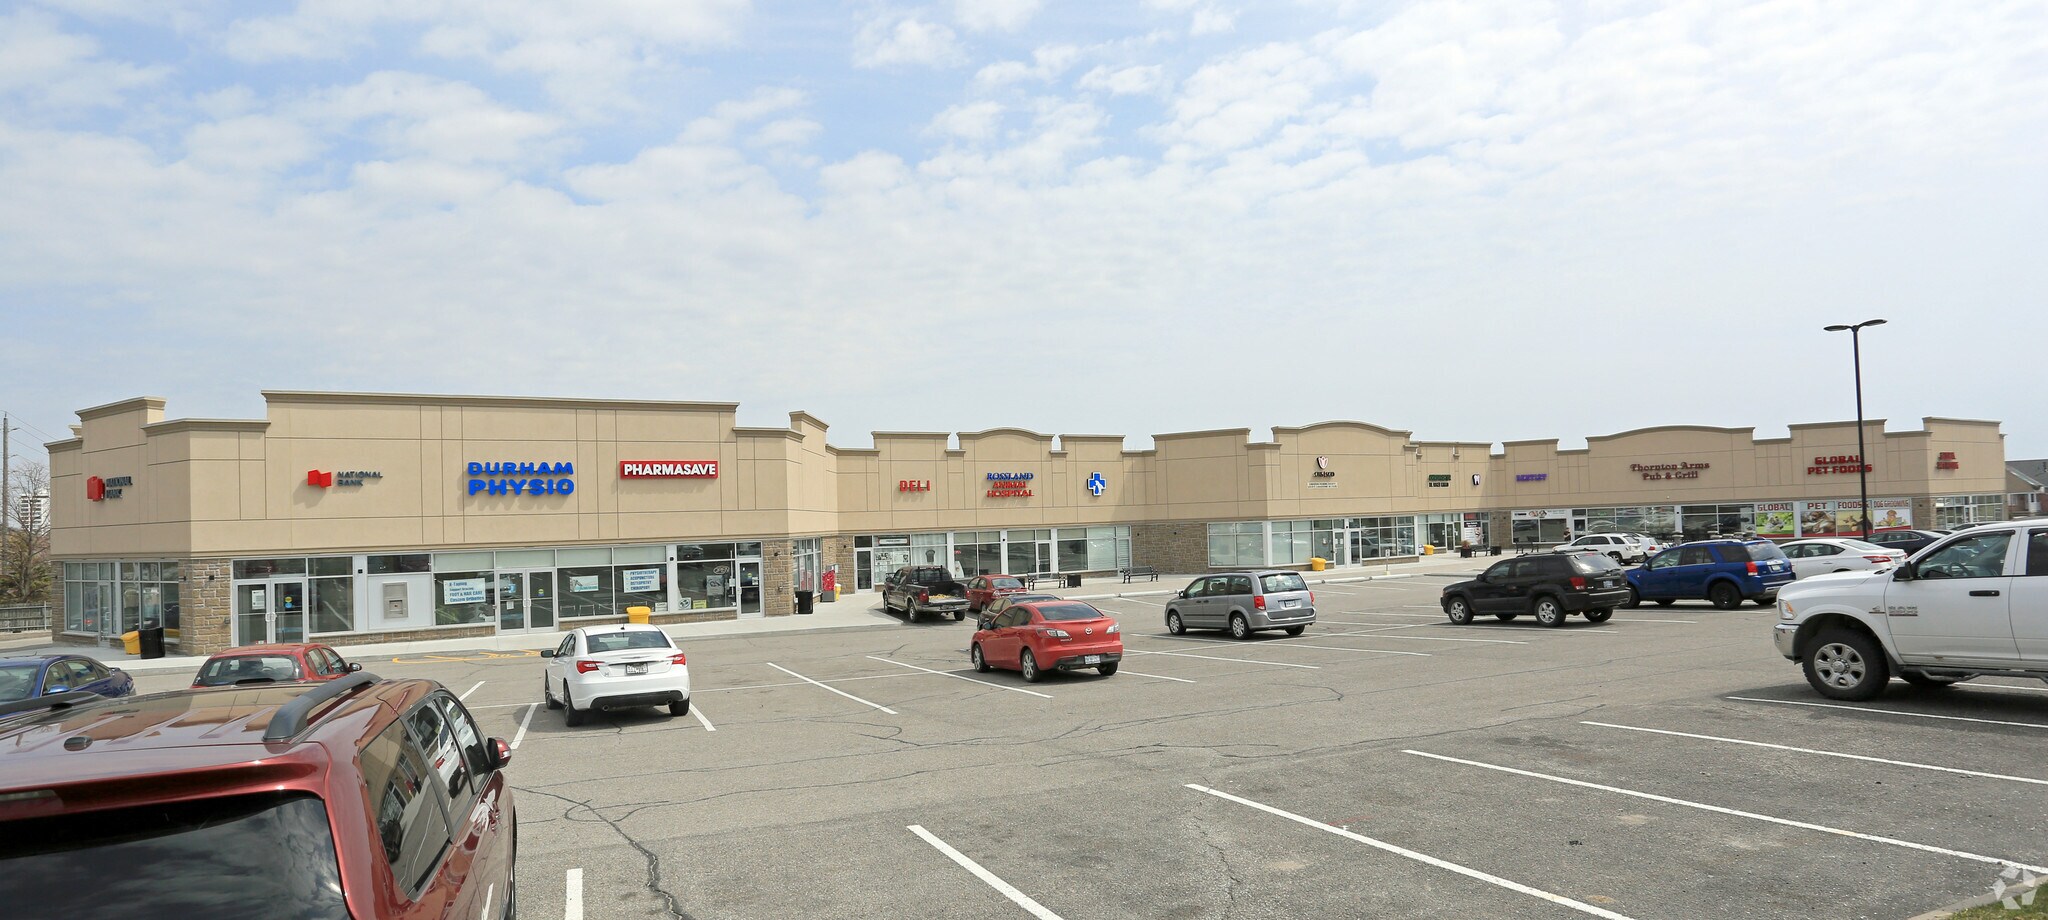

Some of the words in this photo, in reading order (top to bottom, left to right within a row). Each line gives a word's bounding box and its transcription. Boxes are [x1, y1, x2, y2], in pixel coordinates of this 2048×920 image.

[1815, 455, 1861, 465] GLOBAL
[468, 462, 574, 475] DURHAM
[624, 464, 716, 475] PHARMASAVE
[1630, 464, 1678, 472] Thornton
[1807, 466, 1829, 475] PET
[1832, 464, 1873, 474] FOODS
[1642, 472, 1661, 480] Pub
[1665, 472, 1672, 480] &
[1675, 471, 1698, 479] Grill
[468, 479, 574, 496] PHYSIO
[900, 480, 930, 491] DELI
[987, 489, 1034, 497] HOSPITAL
[1757, 503, 1790, 512] GLOBAL
